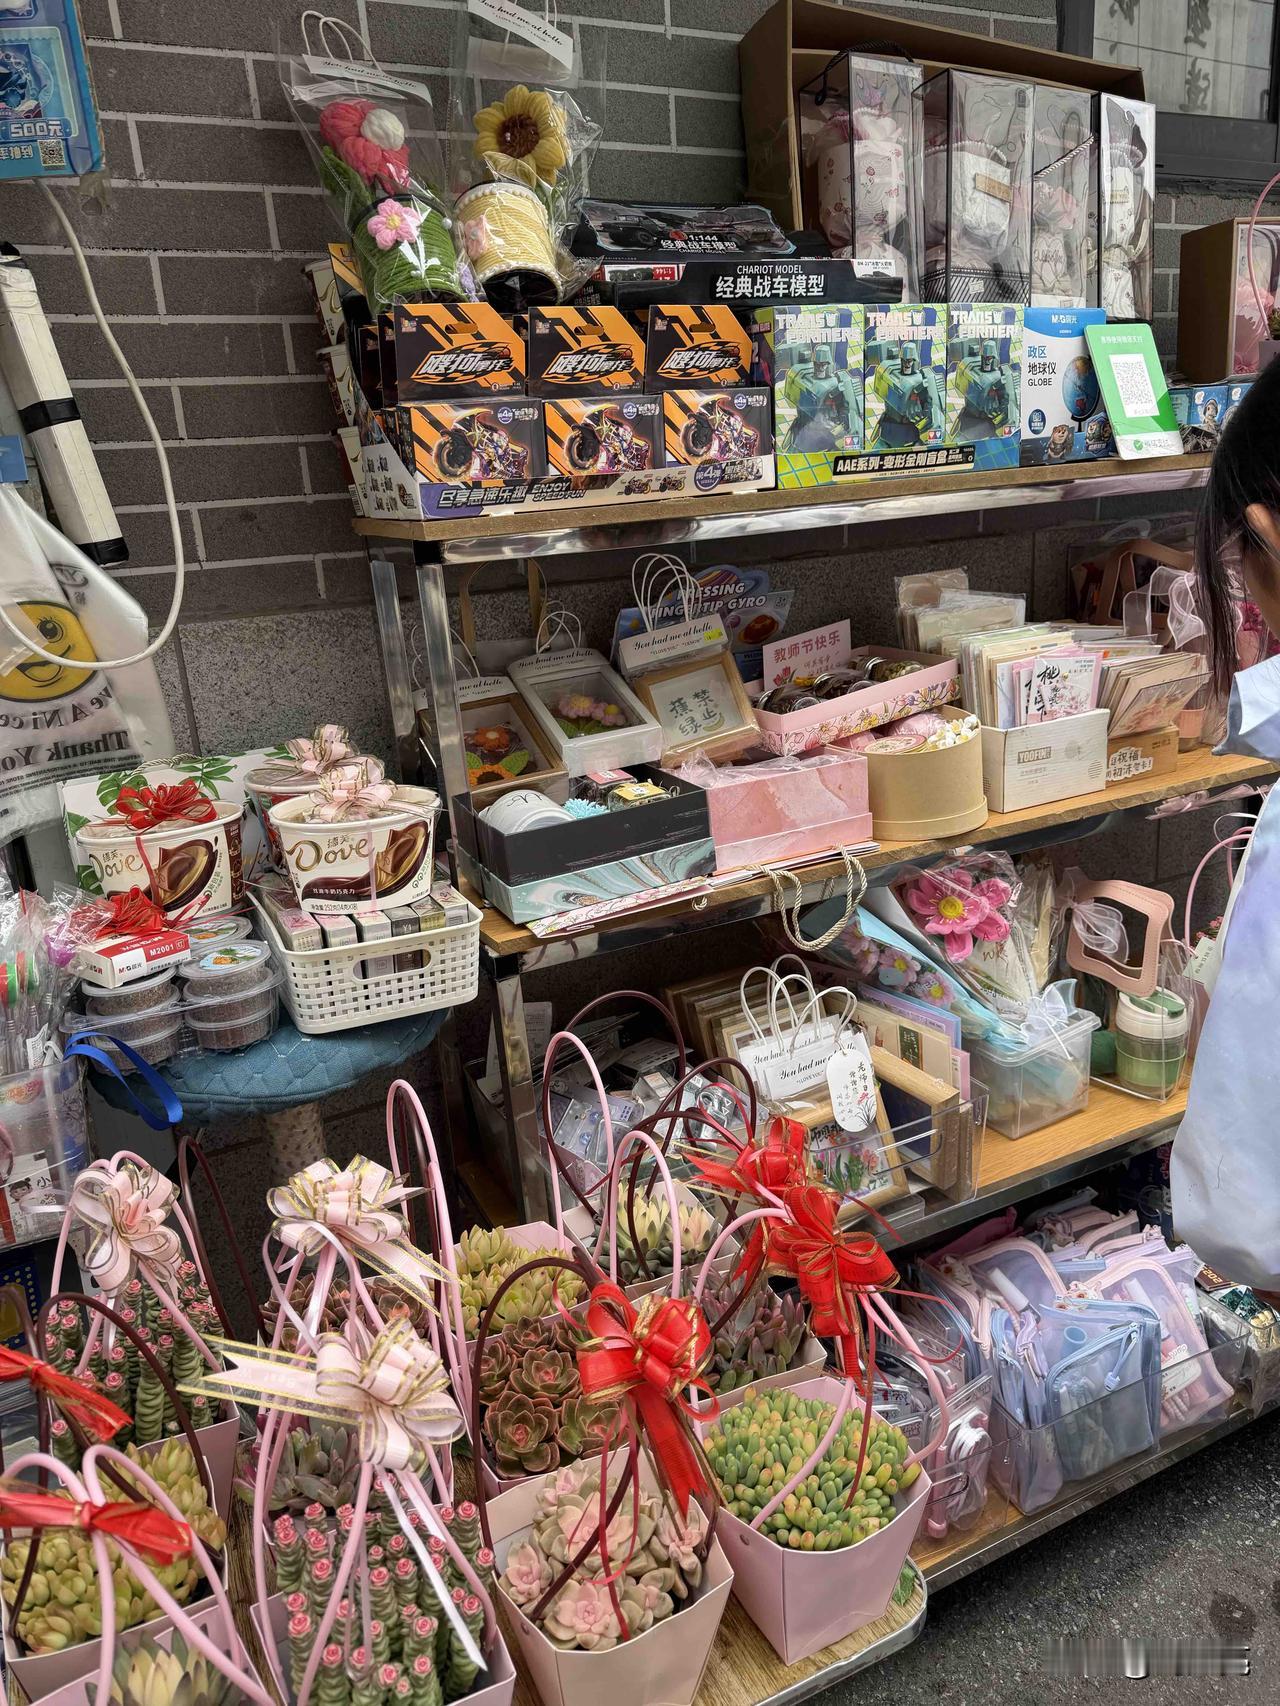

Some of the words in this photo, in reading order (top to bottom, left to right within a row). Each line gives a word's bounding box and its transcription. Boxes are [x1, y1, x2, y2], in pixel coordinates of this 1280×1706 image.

[10, 121, 63, 137] 500元
[737, 264, 773, 275] CHARIOT
[775, 265, 804, 274] MODEL
[715, 274, 825, 299] 经典战车模型
[1027, 345, 1047, 359] 政区
[1027, 362, 1057, 376] 地球仪
[1027, 377, 1053, 387] GLOBE
[531, 481, 571, 494] ENJOY
[532, 491, 567, 503] SPEED
[567, 489, 587, 500] FUN
[727, 595, 767, 610] GYRO
[634, 640, 651, 651] You
[651, 634, 669, 647] had
[669, 633, 682, 641] me
[682, 627, 693, 637] at
[693, 622, 713, 636] hello
[773, 630, 840, 664] 教师节快乐
[518, 660, 534, 669] You
[535, 655, 551, 665] had
[576, 649, 595, 658] hello
[484, 677, 504, 687] hello
[692, 688, 718, 721] 禁止
[286, 838, 375, 872] Dove
[89, 853, 144, 883] Dove
[149, 943, 175, 957] M2001
[780, 1068, 796, 1080] You
[797, 1059, 814, 1074] had
